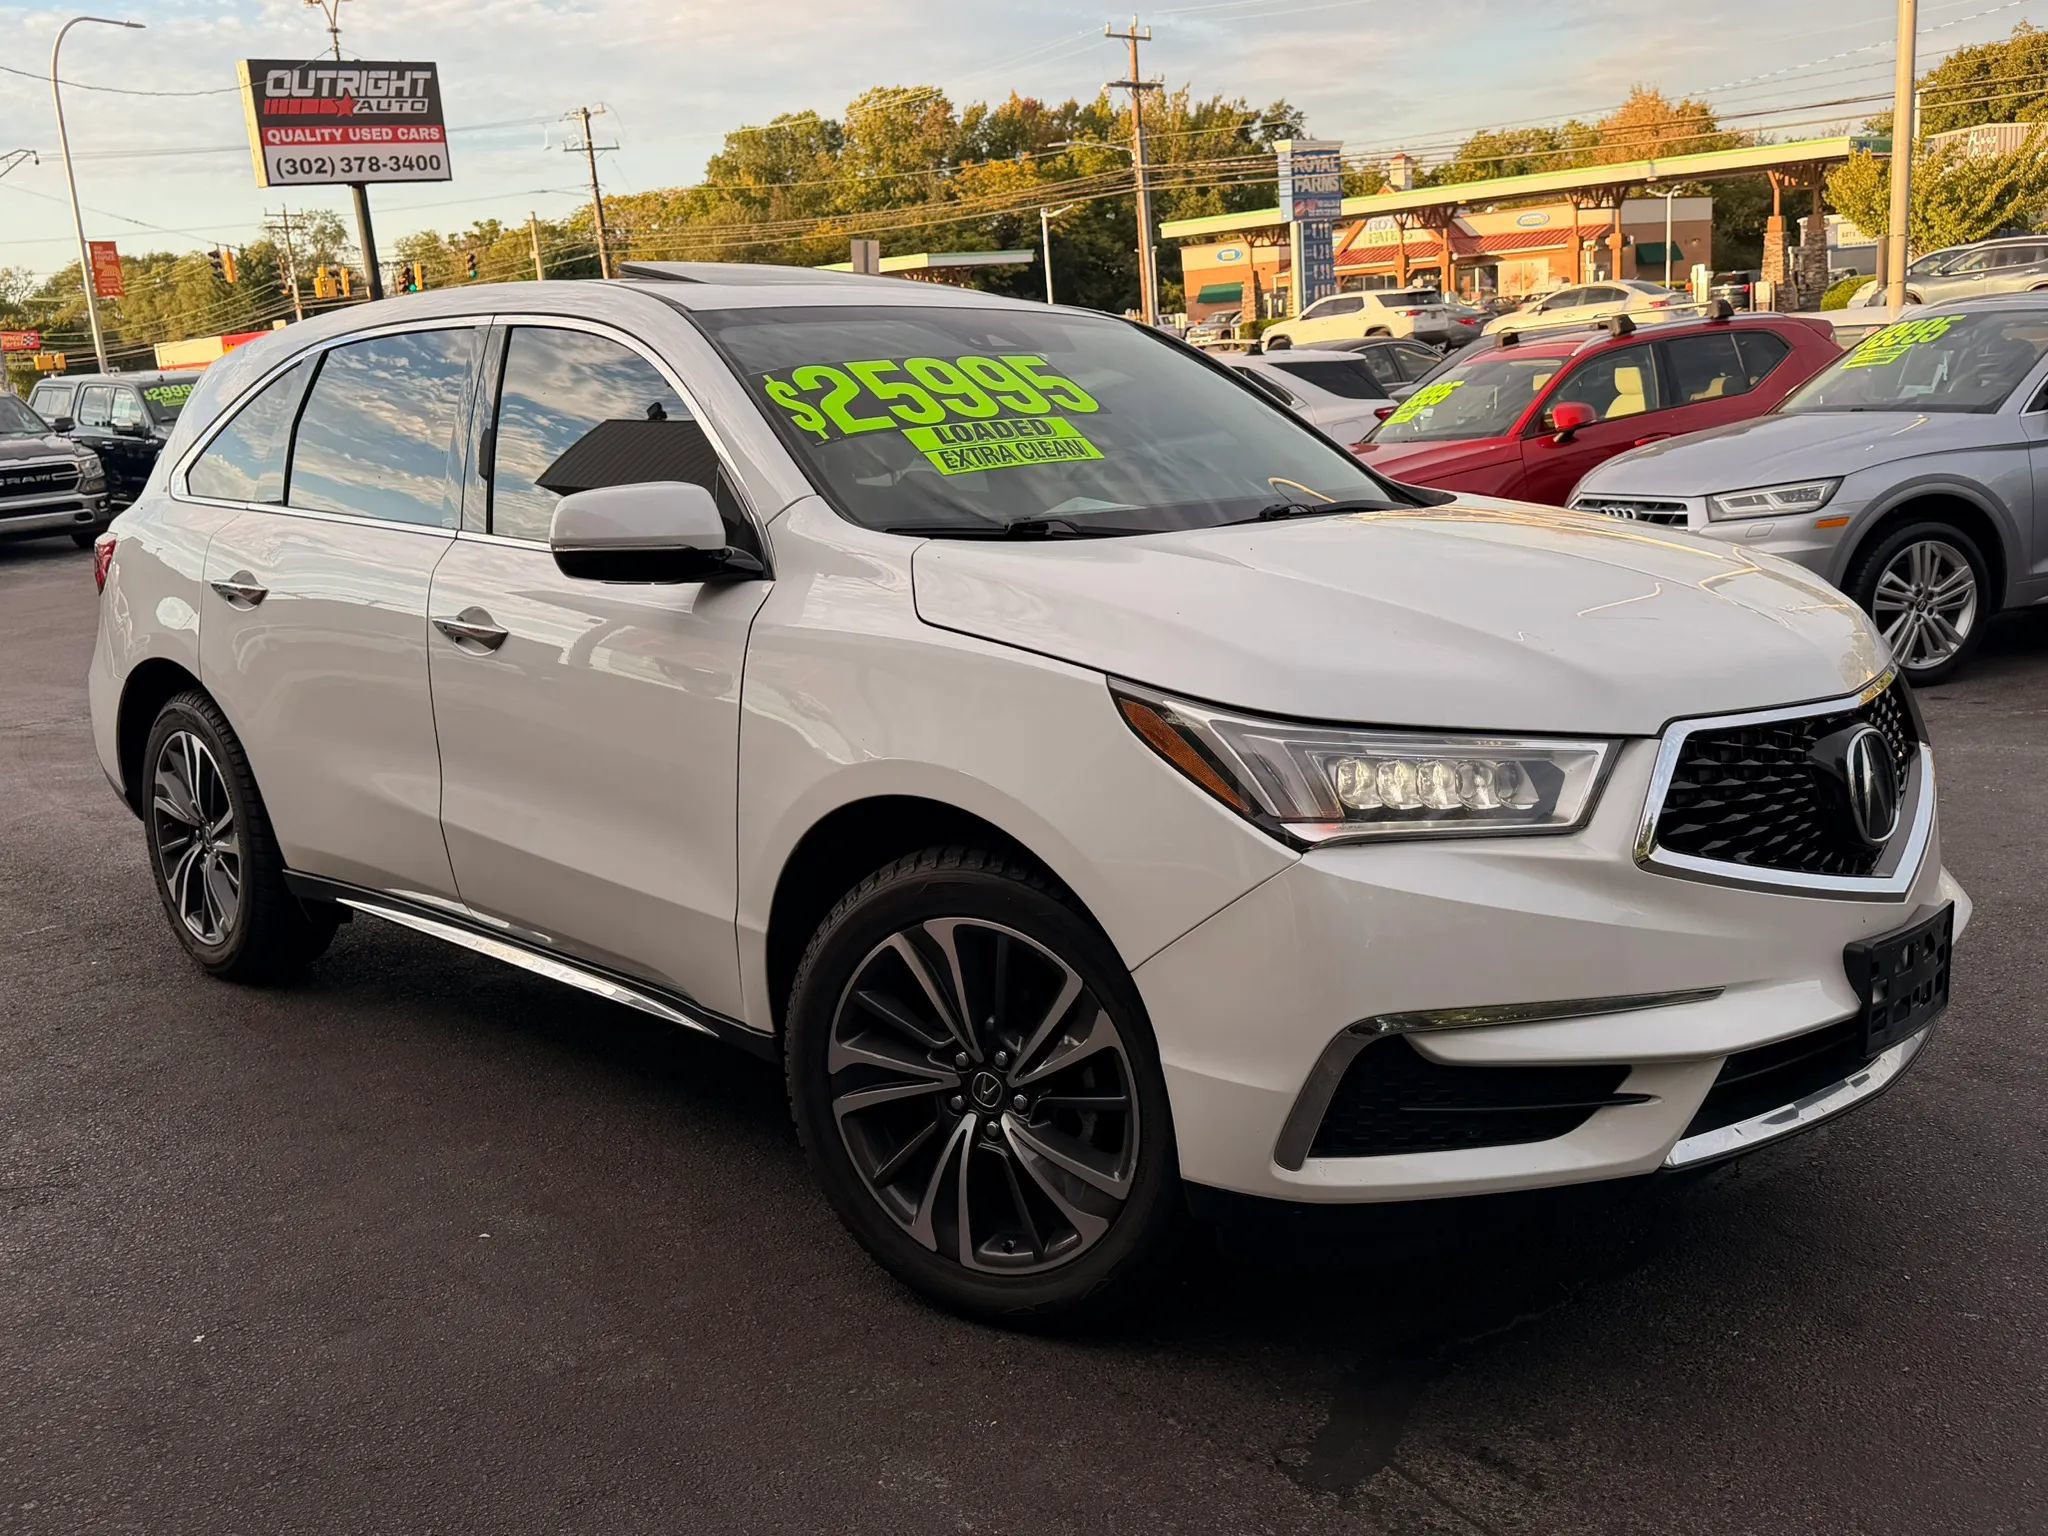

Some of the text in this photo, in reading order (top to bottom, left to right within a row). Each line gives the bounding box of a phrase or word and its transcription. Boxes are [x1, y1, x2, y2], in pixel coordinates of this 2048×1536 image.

[265, 69, 432, 97] OUTRIGHT
[357, 99, 426, 112] AUTO
[267, 127, 440, 144] QUALITY USED CARS
[276, 154, 441, 178] (302) 378-3400
[1294, 174, 1340, 193] FARMS
[144, 384, 194, 401] $2999
[763, 355, 1100, 440] $25995
[931, 417, 1059, 447] LOADED
[938, 439, 1088, 472] EXTRA CLEAN
[6, 474, 50, 485] RAM
